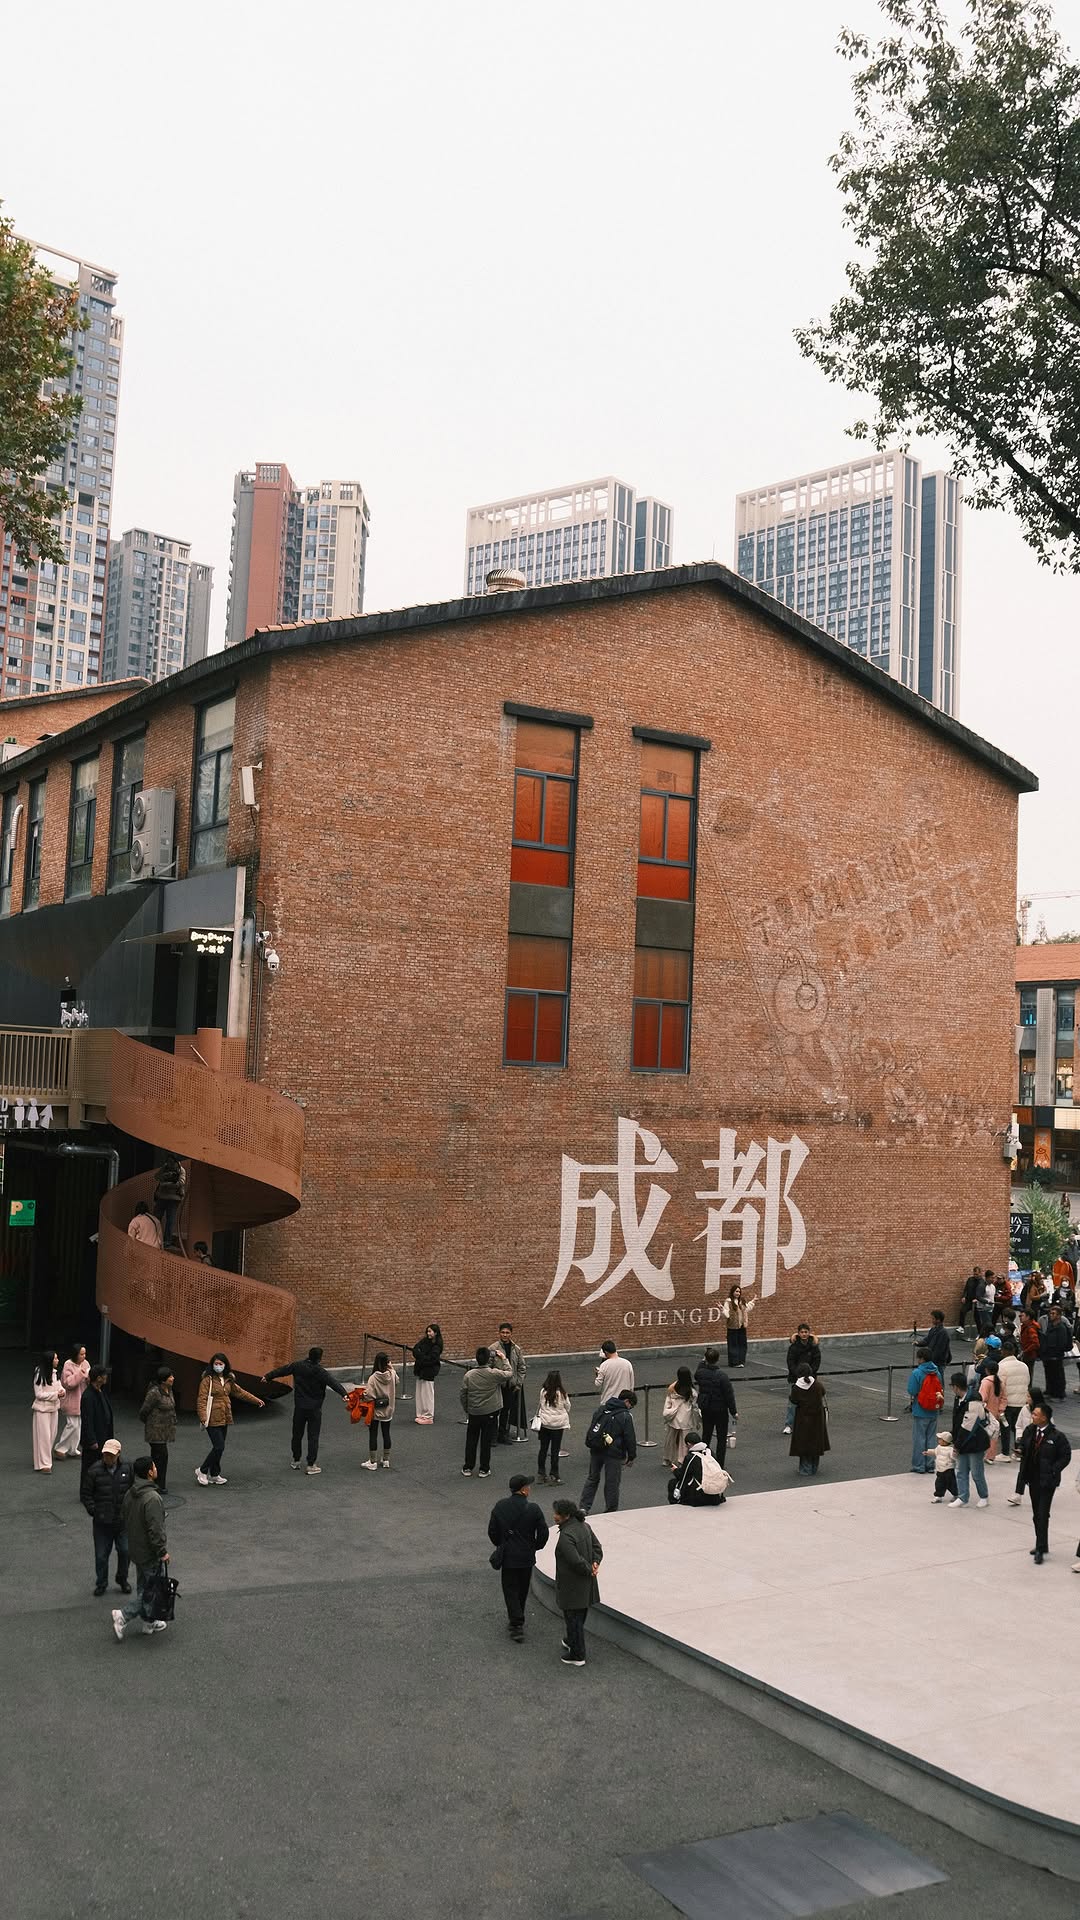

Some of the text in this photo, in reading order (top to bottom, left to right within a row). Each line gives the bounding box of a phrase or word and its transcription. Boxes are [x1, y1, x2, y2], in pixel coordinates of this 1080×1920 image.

[10, 1200, 24, 1216] P
[542, 1116, 810, 1309] 成都
[623, 1307, 721, 1328] CHENGD
